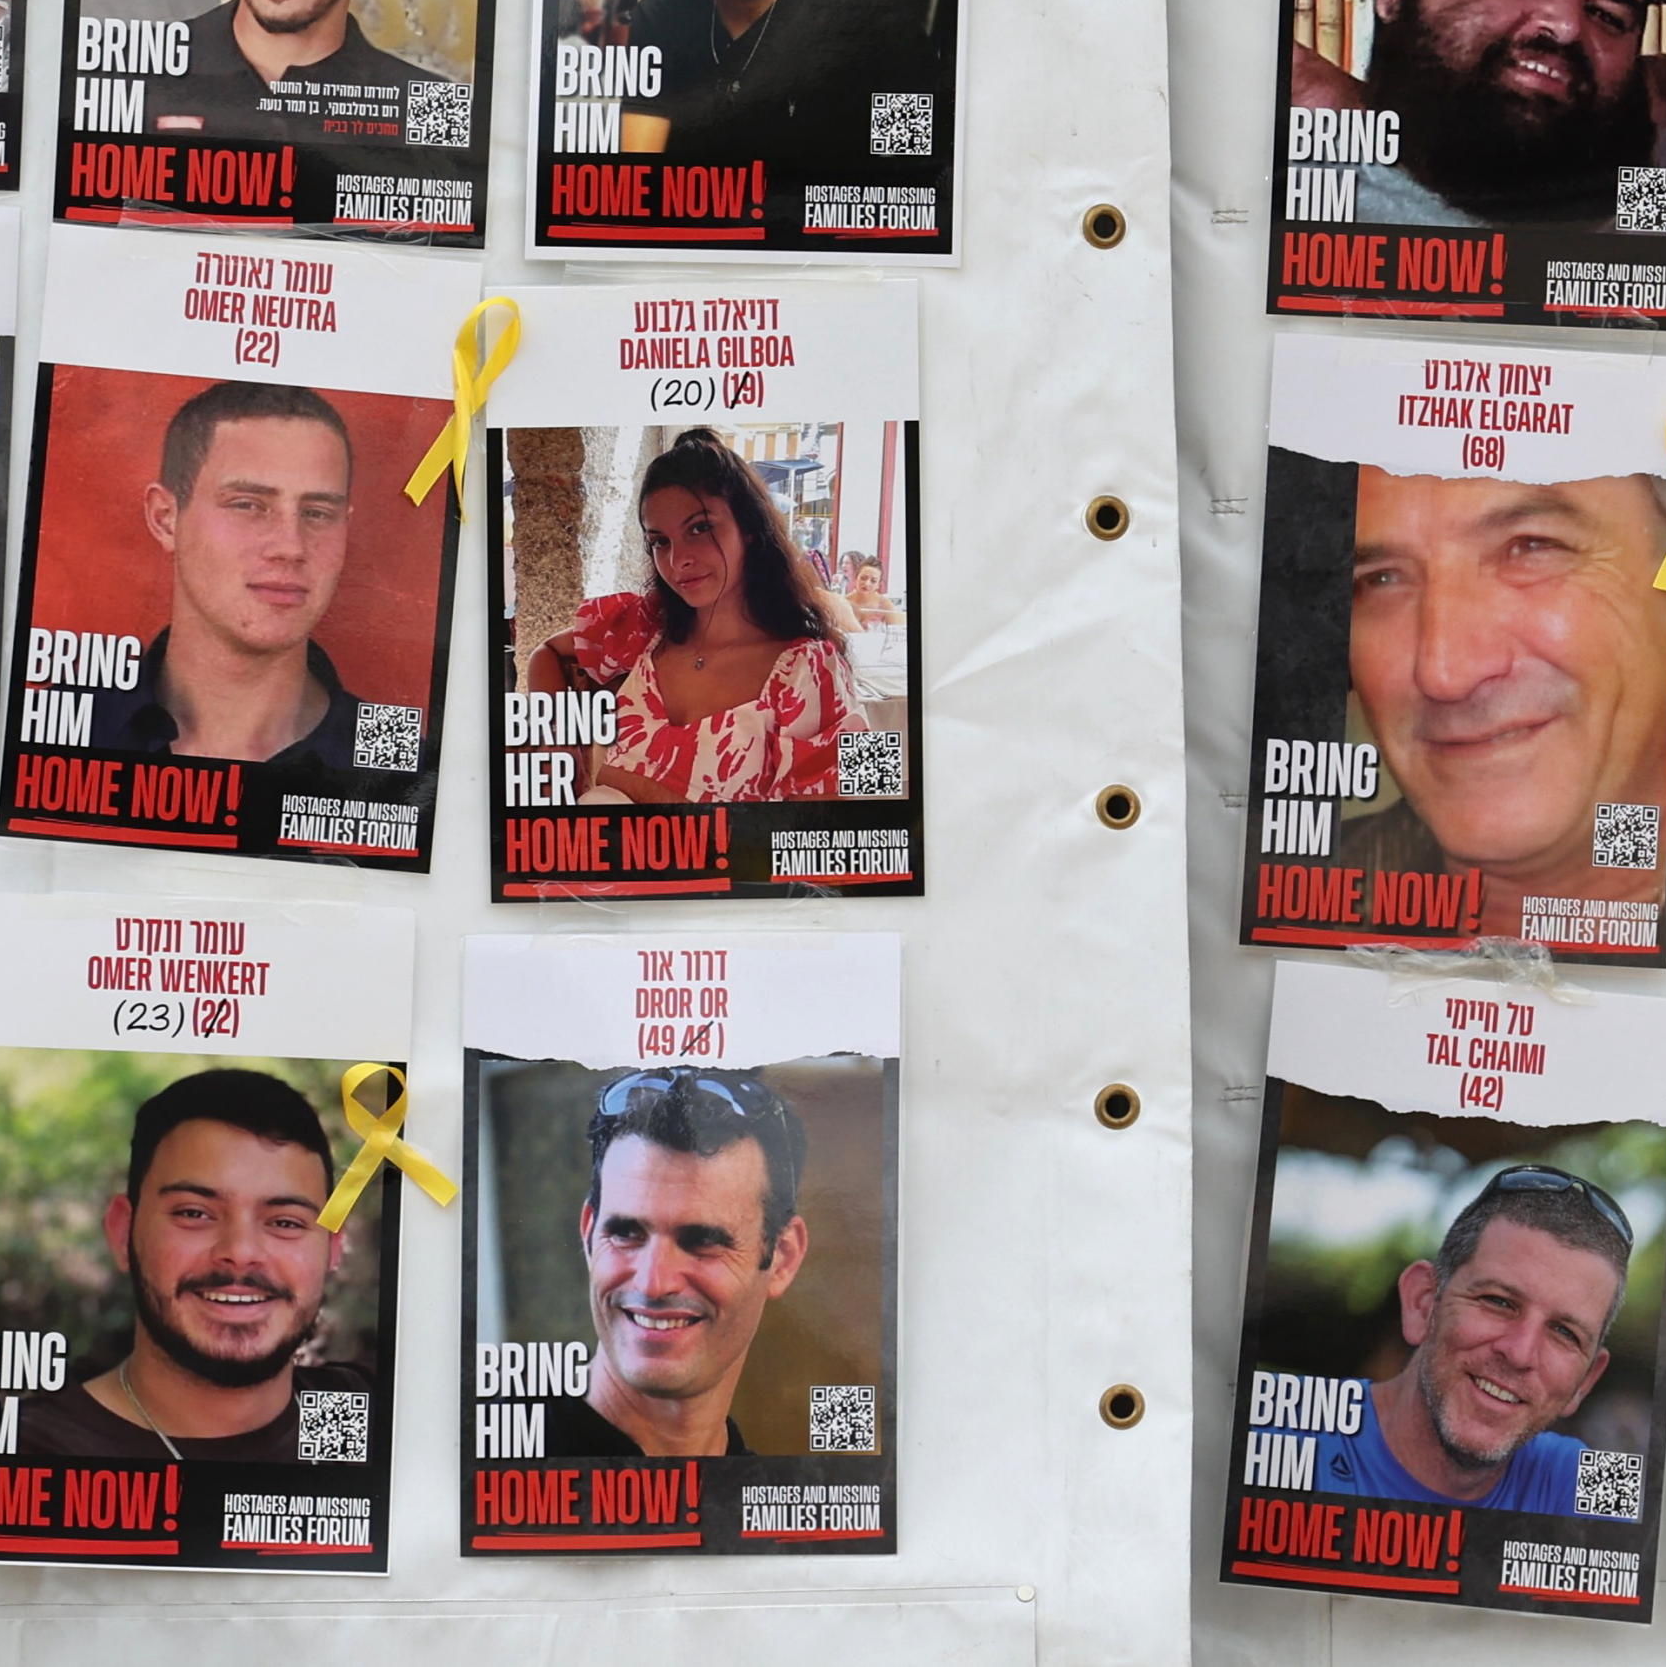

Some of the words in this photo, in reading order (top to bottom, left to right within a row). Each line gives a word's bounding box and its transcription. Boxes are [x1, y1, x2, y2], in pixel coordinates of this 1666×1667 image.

[305, 81, 320, 96] של
[556, 45, 662, 98] BRING
[285, 99, 306, 113] תמר
[309, 101, 320, 115] בן
[383, 105, 399, 118] רום
[554, 102, 620, 154] HIM
[552, 164, 651, 216] HOME
[662, 160, 765, 219] NOW!
[805, 185, 861, 203] HOSTAGES
[864, 186, 885, 203] AND
[887, 187, 936, 205] MISSING
[804, 204, 876, 229] FAMILIES
[879, 205, 935, 230] FORUM
[184, 288, 247, 324] OMER
[251, 294, 337, 332] NEUTRA
[620, 337, 711, 370] DANIELA
[716, 336, 796, 368] GILBOA
[1399, 395, 1474, 429] ITZHAK
[1480, 399, 1574, 434] ELGARAT
[88, 956, 154, 990] OMER
[159, 959, 271, 995] WENKERT
[636, 987, 693, 1019] DROR
[700, 987, 729, 1018] OR
[1426, 1033, 1463, 1067] TAL
[1468, 1038, 1547, 1075] CHAIMI
